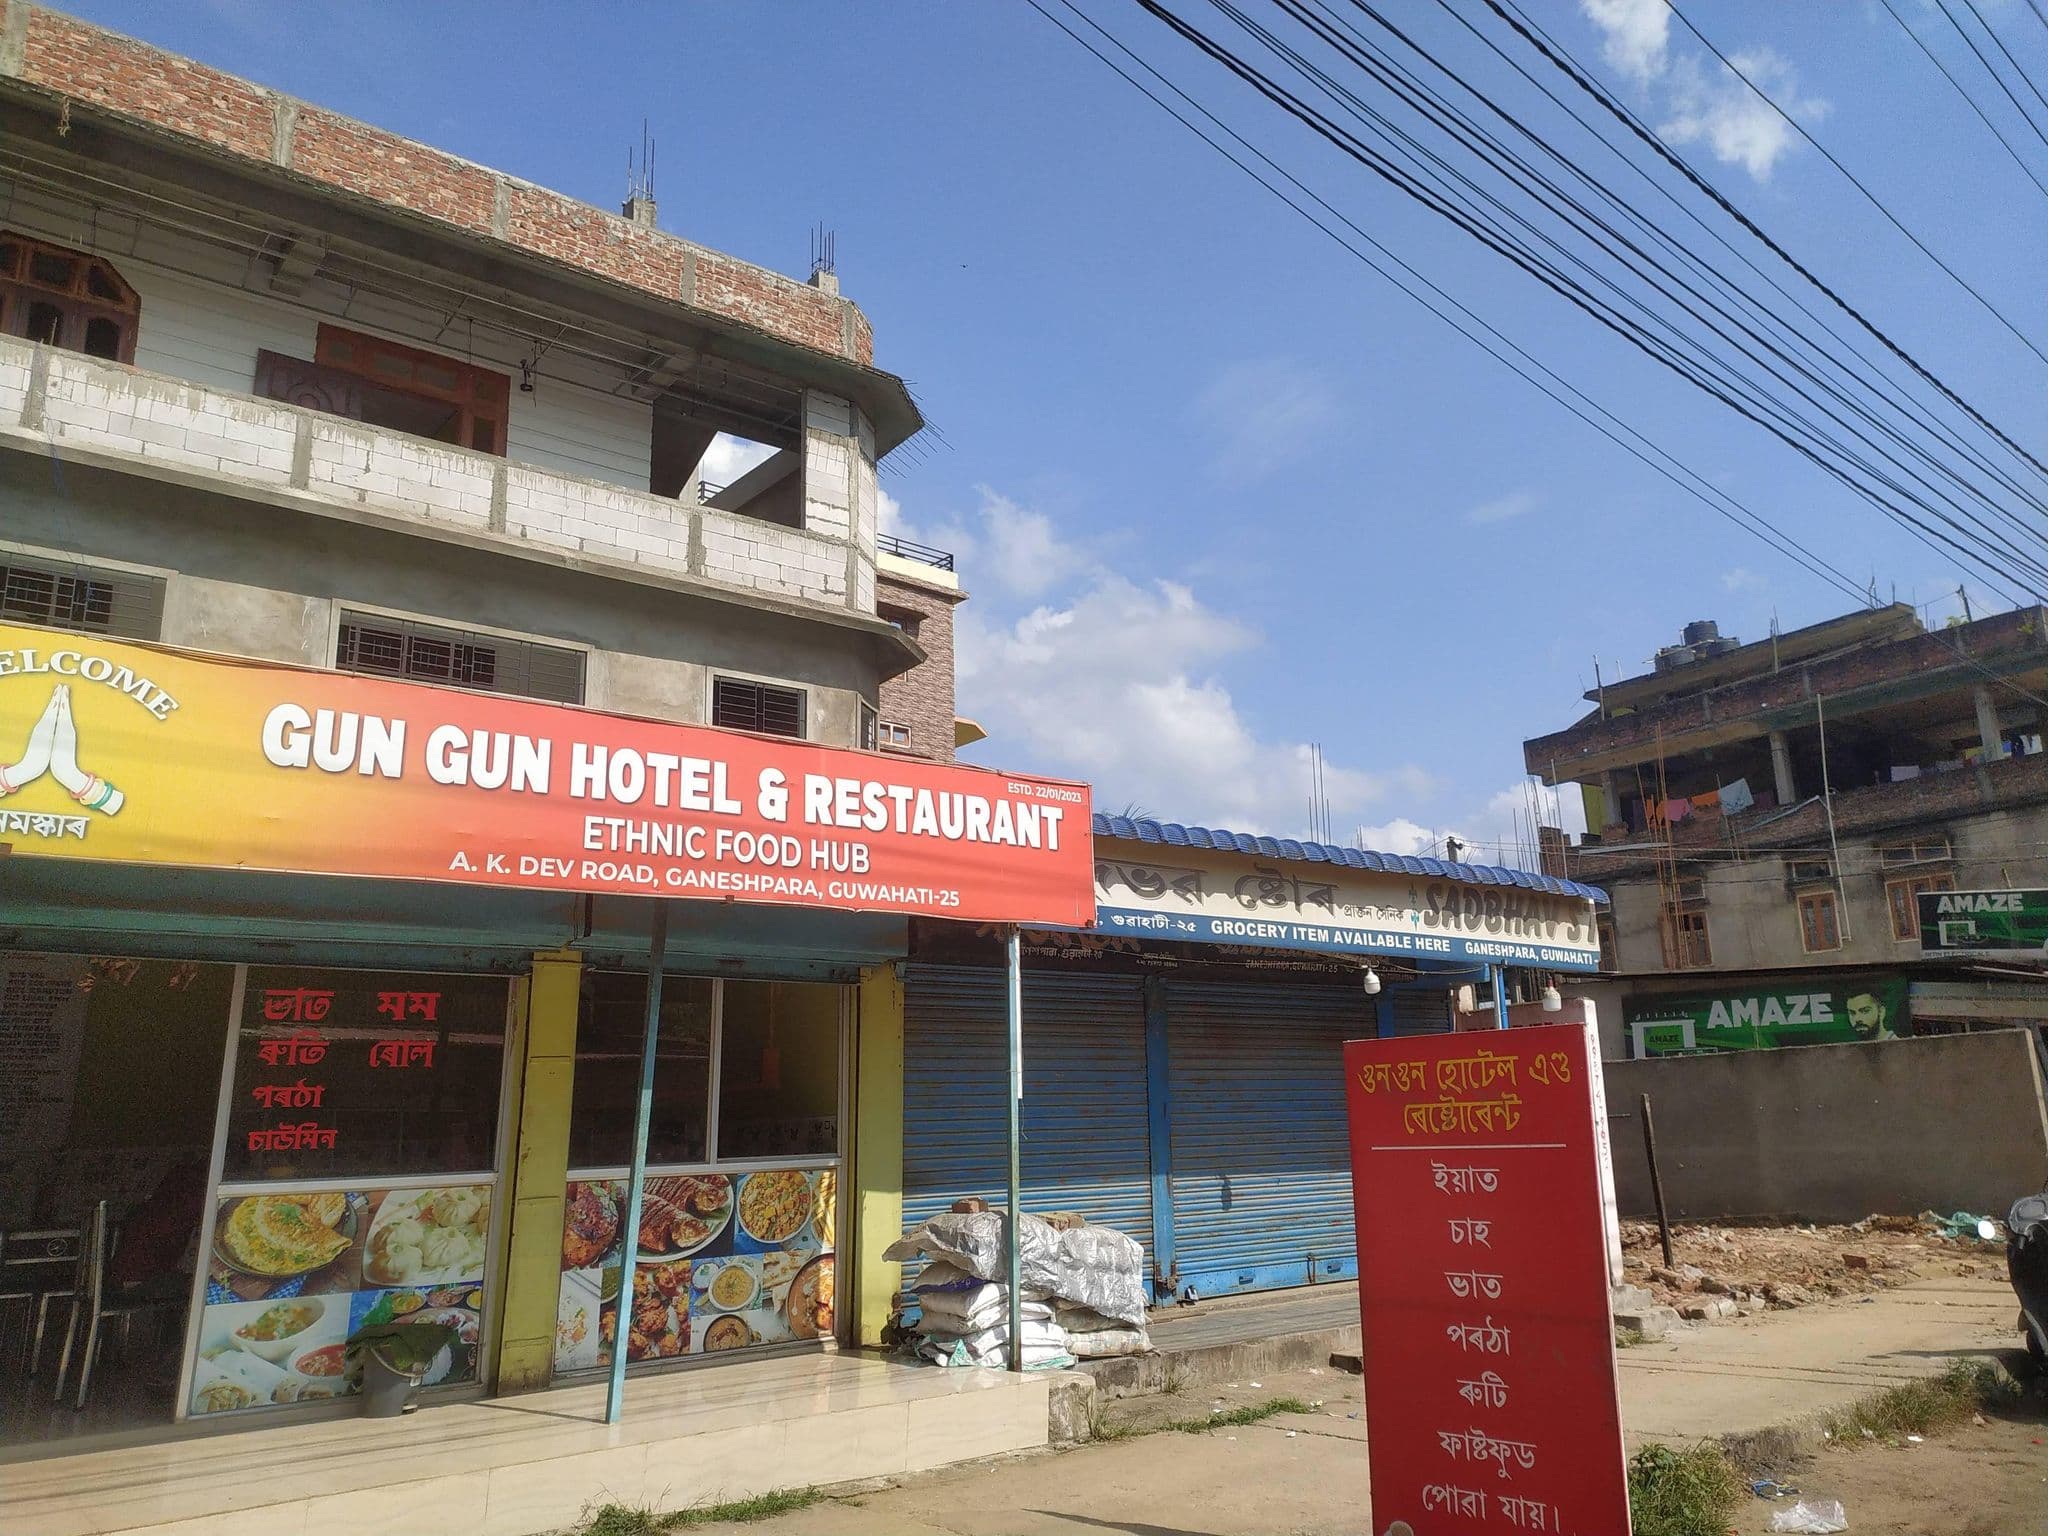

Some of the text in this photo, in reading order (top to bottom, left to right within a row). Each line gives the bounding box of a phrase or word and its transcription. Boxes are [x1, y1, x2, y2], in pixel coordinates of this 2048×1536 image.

[0, 648, 181, 721] ELCOME
[262, 703, 1063, 851] GUN GUN HOTEL & RESTAURANT
[1007, 782, 1083, 804] ESTD. 22/01/2023
[583, 816, 871, 874] ETHNIC FOOD HUB
[449, 852, 960, 907] A. K. DEV ROAD, GANESHPARA, GUWAHATI-25
[1423, 883, 1561, 942] SADBHAV
[1936, 893, 2025, 914] AMAZE
[1211, 919, 1287, 939] GROCERY
[1292, 926, 1330, 943] ITEM
[1333, 928, 1413, 951] AVAILABLE
[1416, 934, 1451, 953] HERE
[1465, 940, 1539, 962] GANESHPARA,
[376, 991, 442, 1021] মম
[1706, 993, 1835, 1030] AMAZE
[1436, 1049, 1518, 1095] হোটেল
[1448, 1217, 1492, 1249] চাহ
[1444, 1270, 1503, 1299] ভাত
[1446, 1315, 1511, 1357] পৰঠা
